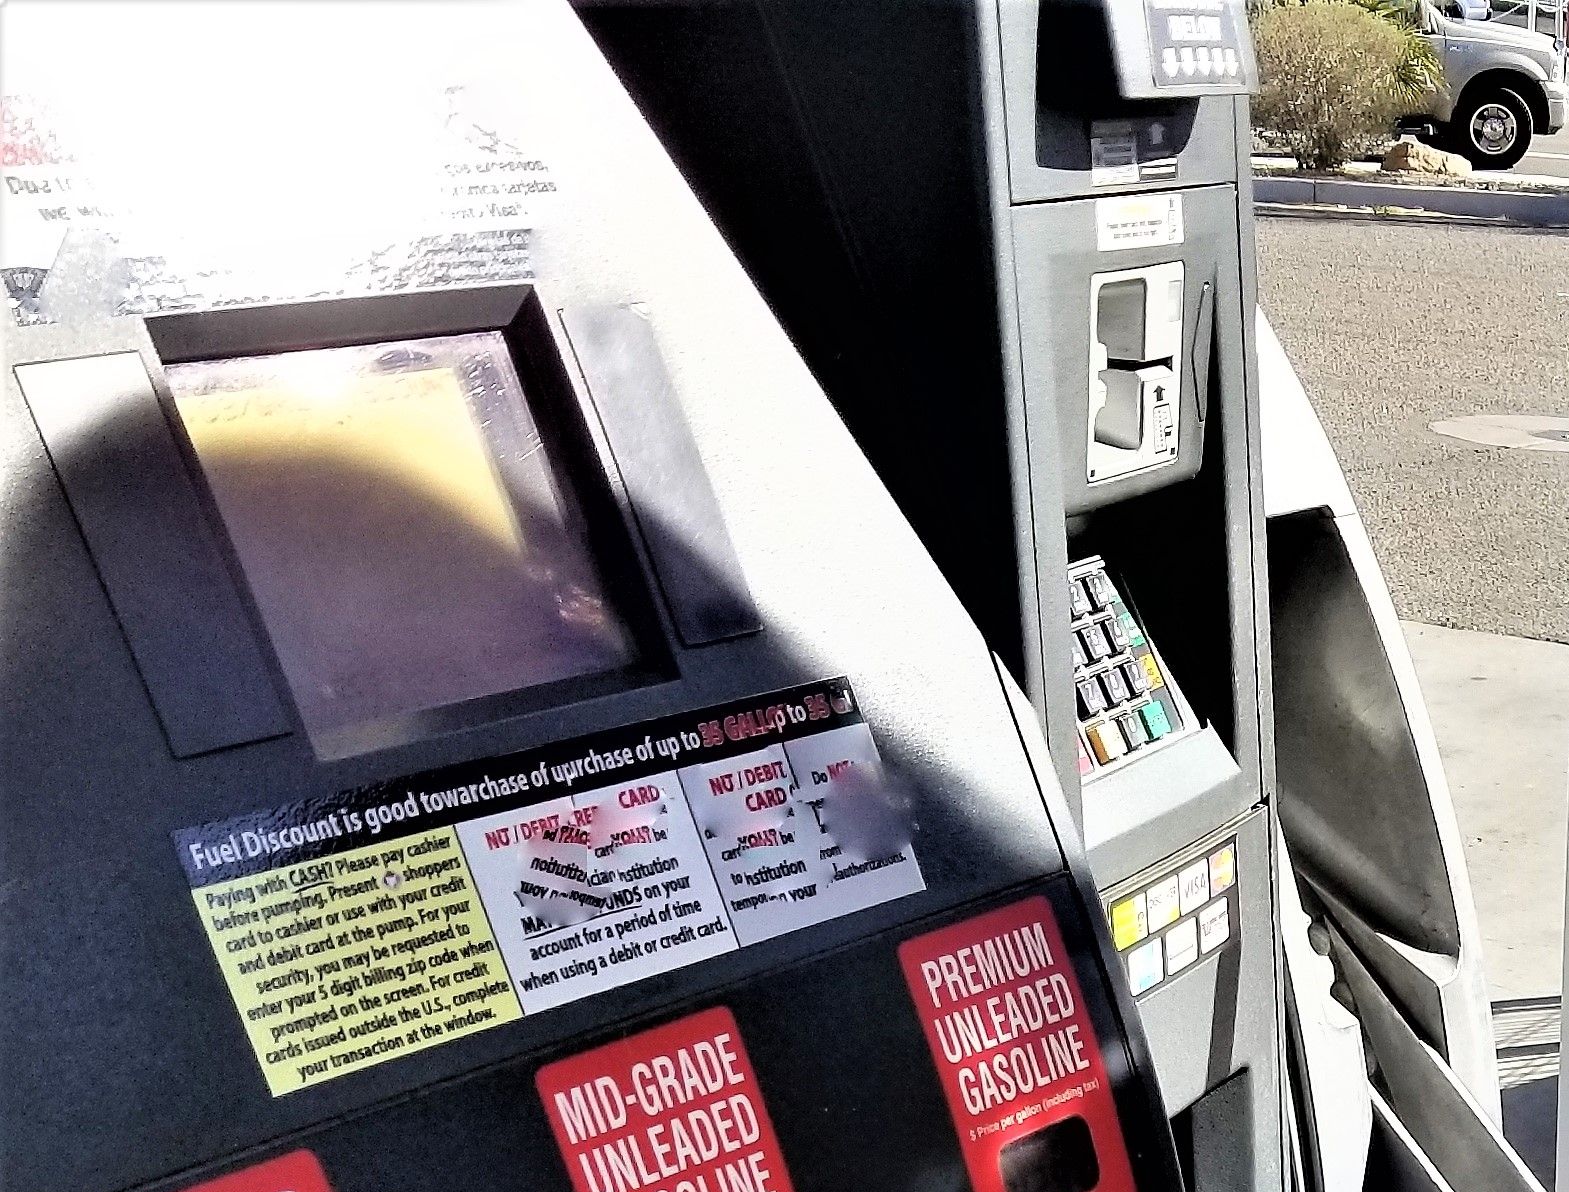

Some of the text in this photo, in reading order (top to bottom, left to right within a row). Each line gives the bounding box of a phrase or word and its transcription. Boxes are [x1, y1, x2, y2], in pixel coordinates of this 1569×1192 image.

[189, 837, 240, 869] Fuel
[242, 821, 341, 856] Discount
[341, 810, 361, 833] is
[365, 794, 419, 834] good
[530, 762, 550, 787] of
[636, 736, 655, 760] of
[655, 736, 680, 760] up
[681, 731, 701, 750] to
[786, 704, 806, 723] to
[618, 785, 660, 809] CARD
[746, 787, 787, 812] CARD
[206, 835, 452, 910] Paying with CASH? Please pay cashier
[212, 857, 462, 932] before pumping. Present shoppers
[644, 876, 690, 897] on your
[226, 877, 467, 953] card to cashier or use with your credit
[237, 899, 471, 975] and debit card at the pump. For your
[530, 900, 702, 960] account for a period of time
[246, 940, 495, 1022] enter your 5 digit billing zip code when
[256, 923, 470, 995] security, you may be requested to
[520, 916, 728, 992] when using a debit or credit card.
[921, 922, 1054, 1008] PREMIUM
[265, 1042, 303, 1064] cards
[304, 1026, 346, 1053] issued
[348, 1010, 398, 1039] outside
[397, 1003, 421, 1022] the
[452, 980, 510, 1010] complete
[270, 962, 490, 1042] prompted on the screen. For credit
[935, 973, 1075, 1064] UNLEADED
[297, 1005, 497, 1083] your transaction at the window.
[958, 1024, 1091, 1116] GASOLINE
[553, 1033, 745, 1144] MID-GRADE
[977, 1119, 1000, 1138] Price
[999, 1113, 1015, 1131] per
[1016, 1101, 1042, 1125] gallon
[1043, 1086, 1083, 1112] (including
[1083, 1077, 1100, 1094] tax)
